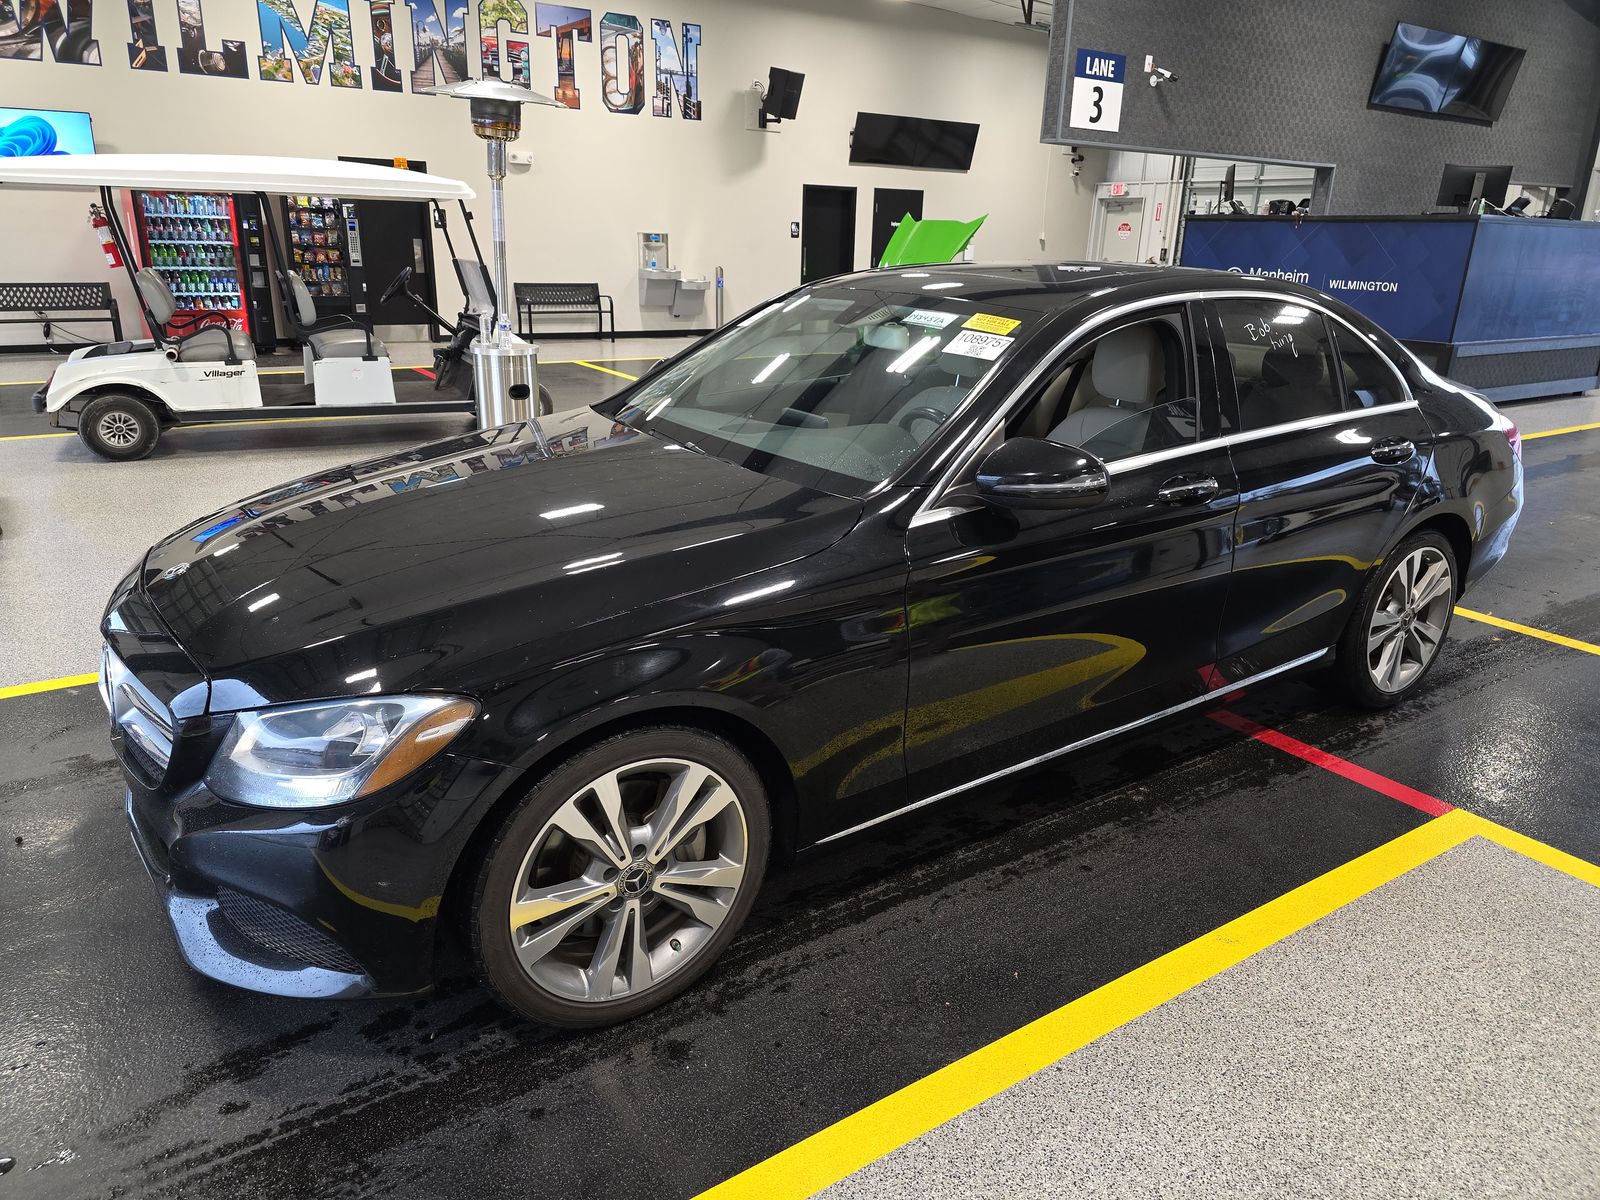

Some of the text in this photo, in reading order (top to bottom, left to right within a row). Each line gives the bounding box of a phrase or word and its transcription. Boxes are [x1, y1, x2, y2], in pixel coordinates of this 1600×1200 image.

[0, 0, 702, 121] WILMINGTON
[1086, 57, 1116, 78] LANE
[1089, 86, 1104, 123] 3
[1329, 279, 1399, 293] WILMINGTON
[1243, 317, 1271, 341] Bob
[959, 333, 1012, 349] 1089757
[203, 370, 246, 378] Villager
